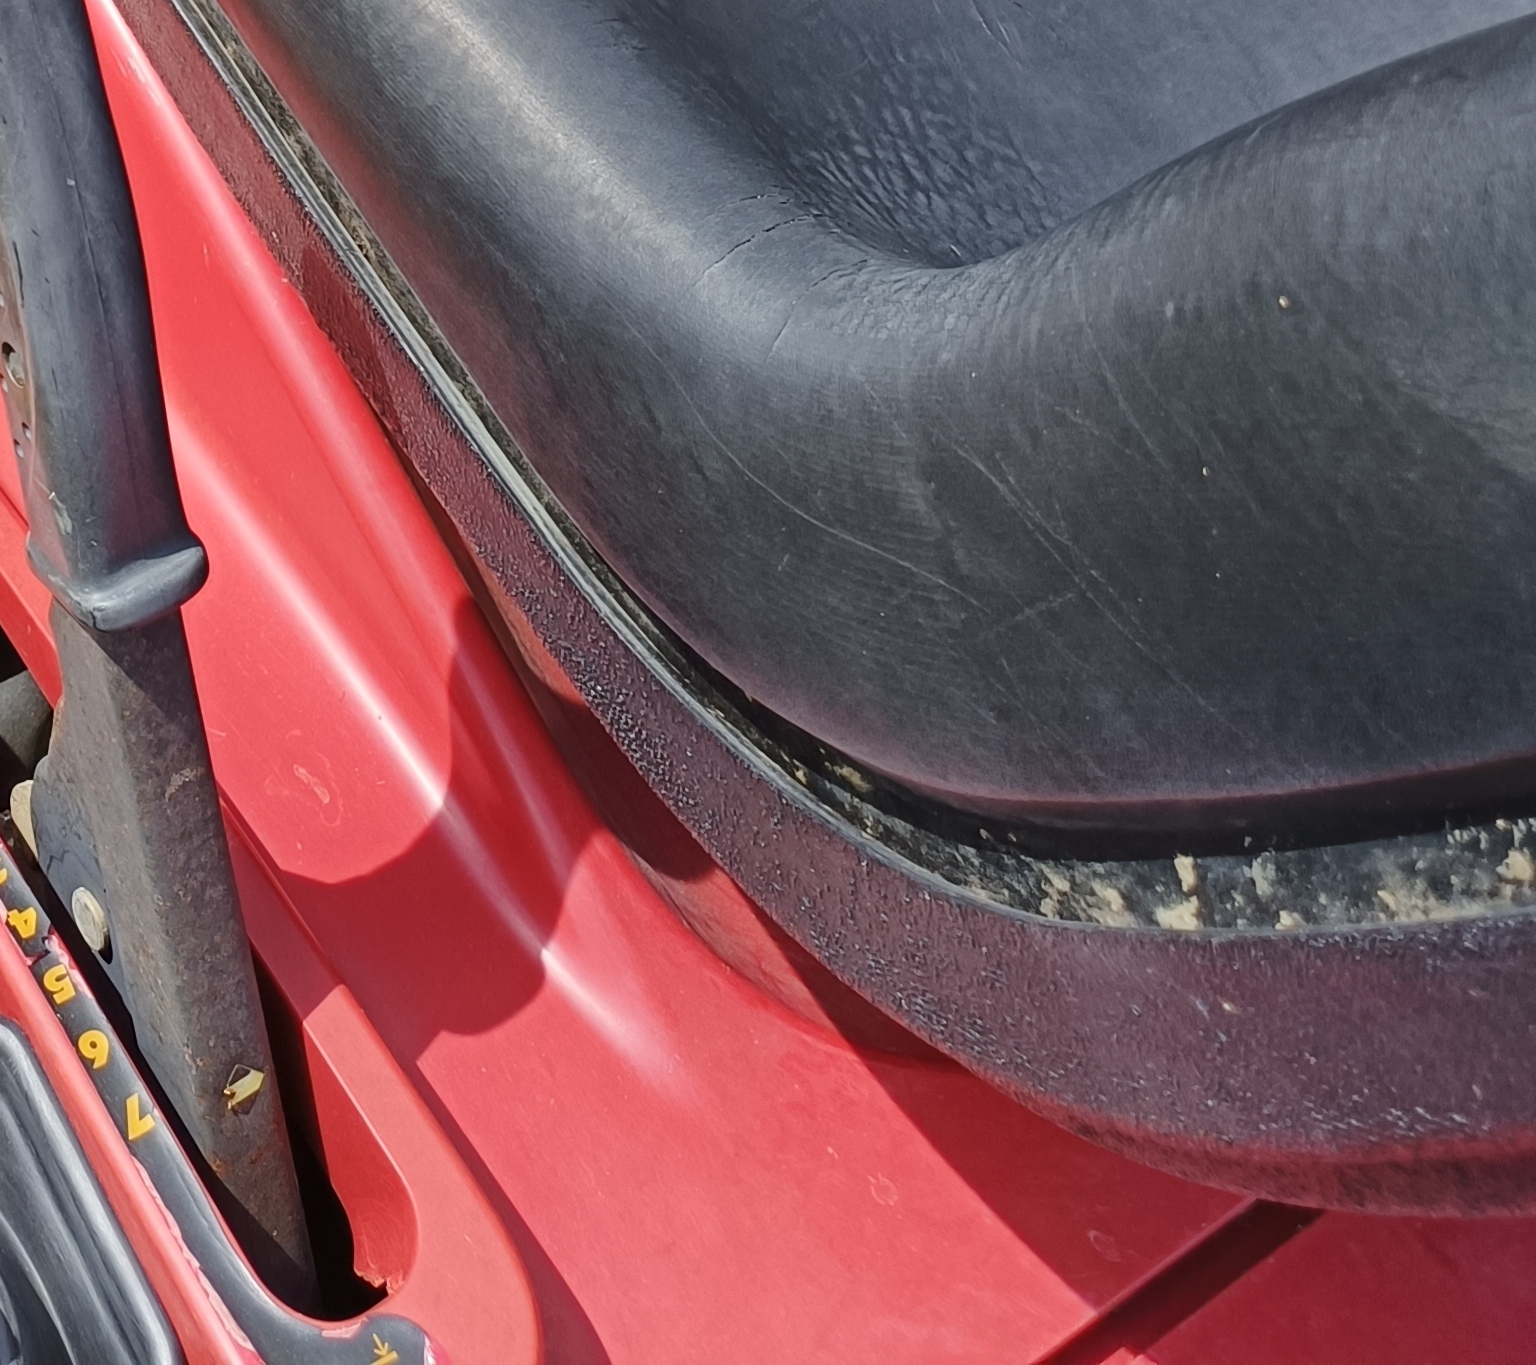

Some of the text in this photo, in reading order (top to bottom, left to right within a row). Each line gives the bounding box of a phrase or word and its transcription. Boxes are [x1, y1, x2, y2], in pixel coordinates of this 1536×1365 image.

[7, 906, 38, 939] 4
[42, 963, 76, 1005] 5
[77, 1029, 110, 1070] 6
[125, 1092, 156, 1141] 7
